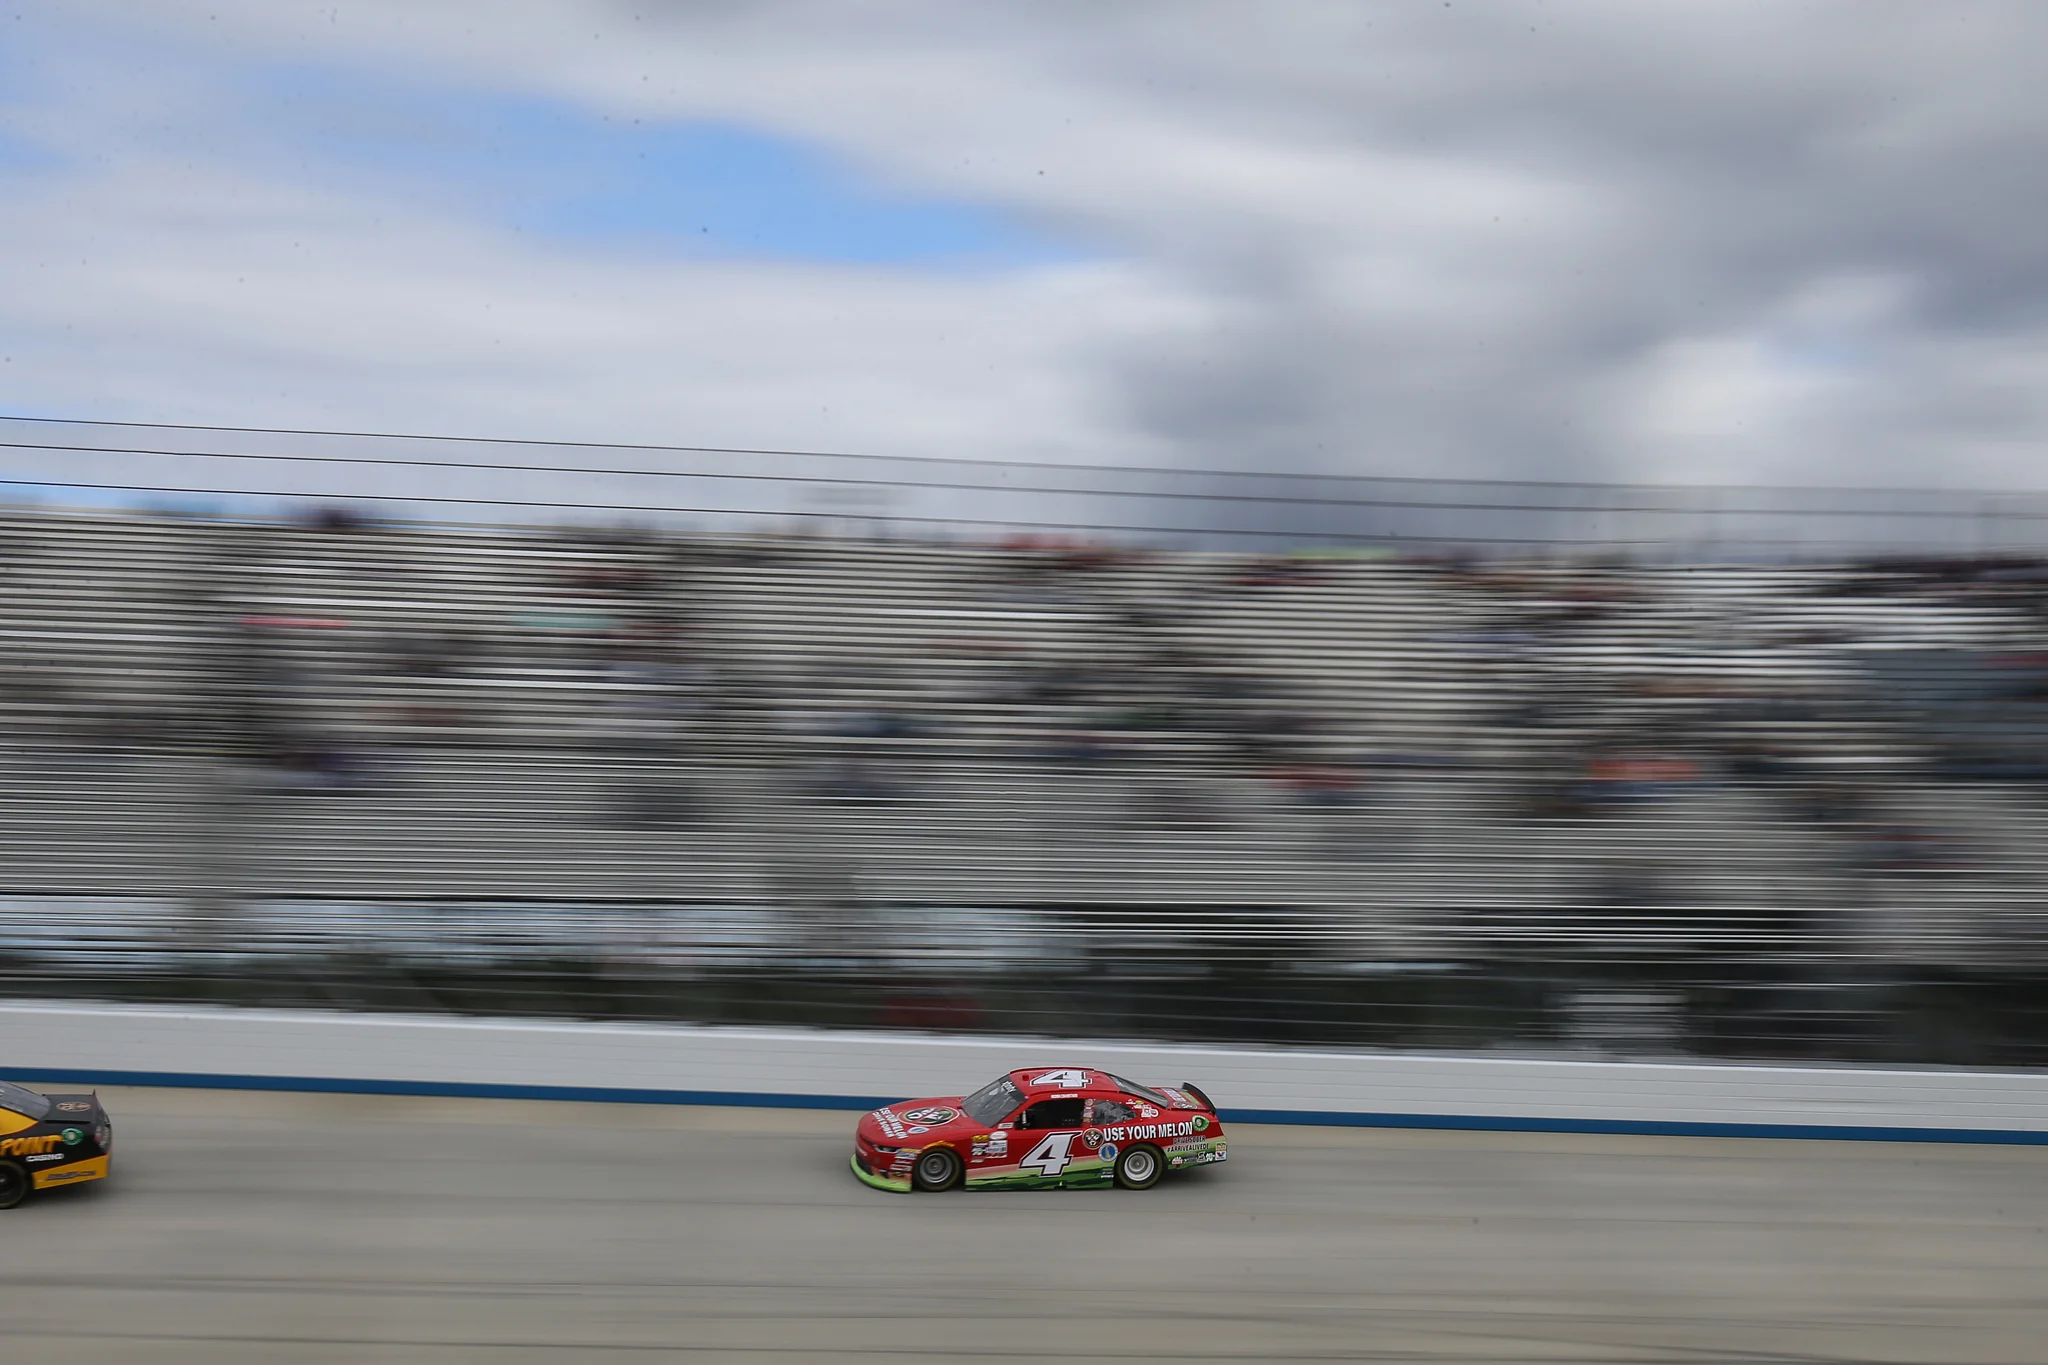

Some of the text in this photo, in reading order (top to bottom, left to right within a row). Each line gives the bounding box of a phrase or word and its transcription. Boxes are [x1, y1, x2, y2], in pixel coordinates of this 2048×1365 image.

[1029, 1069, 1093, 1089] 4
[1103, 1126, 1125, 1142] USE
[1126, 1124, 1157, 1141] YOUR
[1158, 1121, 1193, 1138] MELON
[1017, 1130, 1083, 1178] 4
